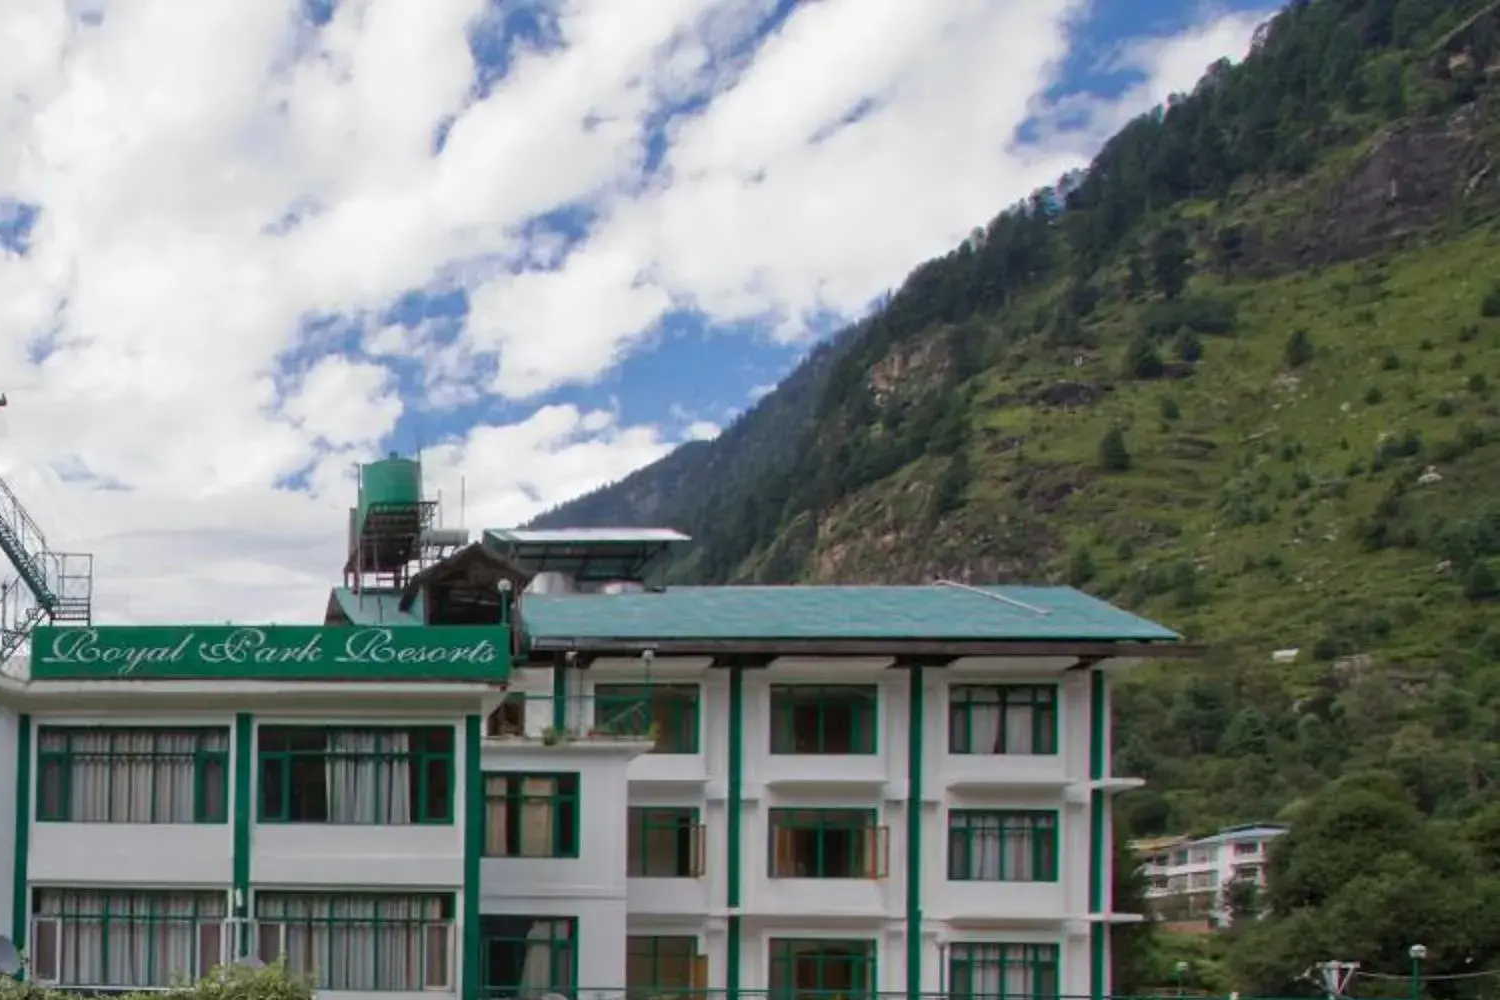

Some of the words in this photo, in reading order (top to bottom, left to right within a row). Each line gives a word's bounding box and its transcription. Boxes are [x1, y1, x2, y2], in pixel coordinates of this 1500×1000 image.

[42, 627, 195, 676] Royal
[199, 627, 323, 664] Park
[334, 627, 497, 664] Resorts
